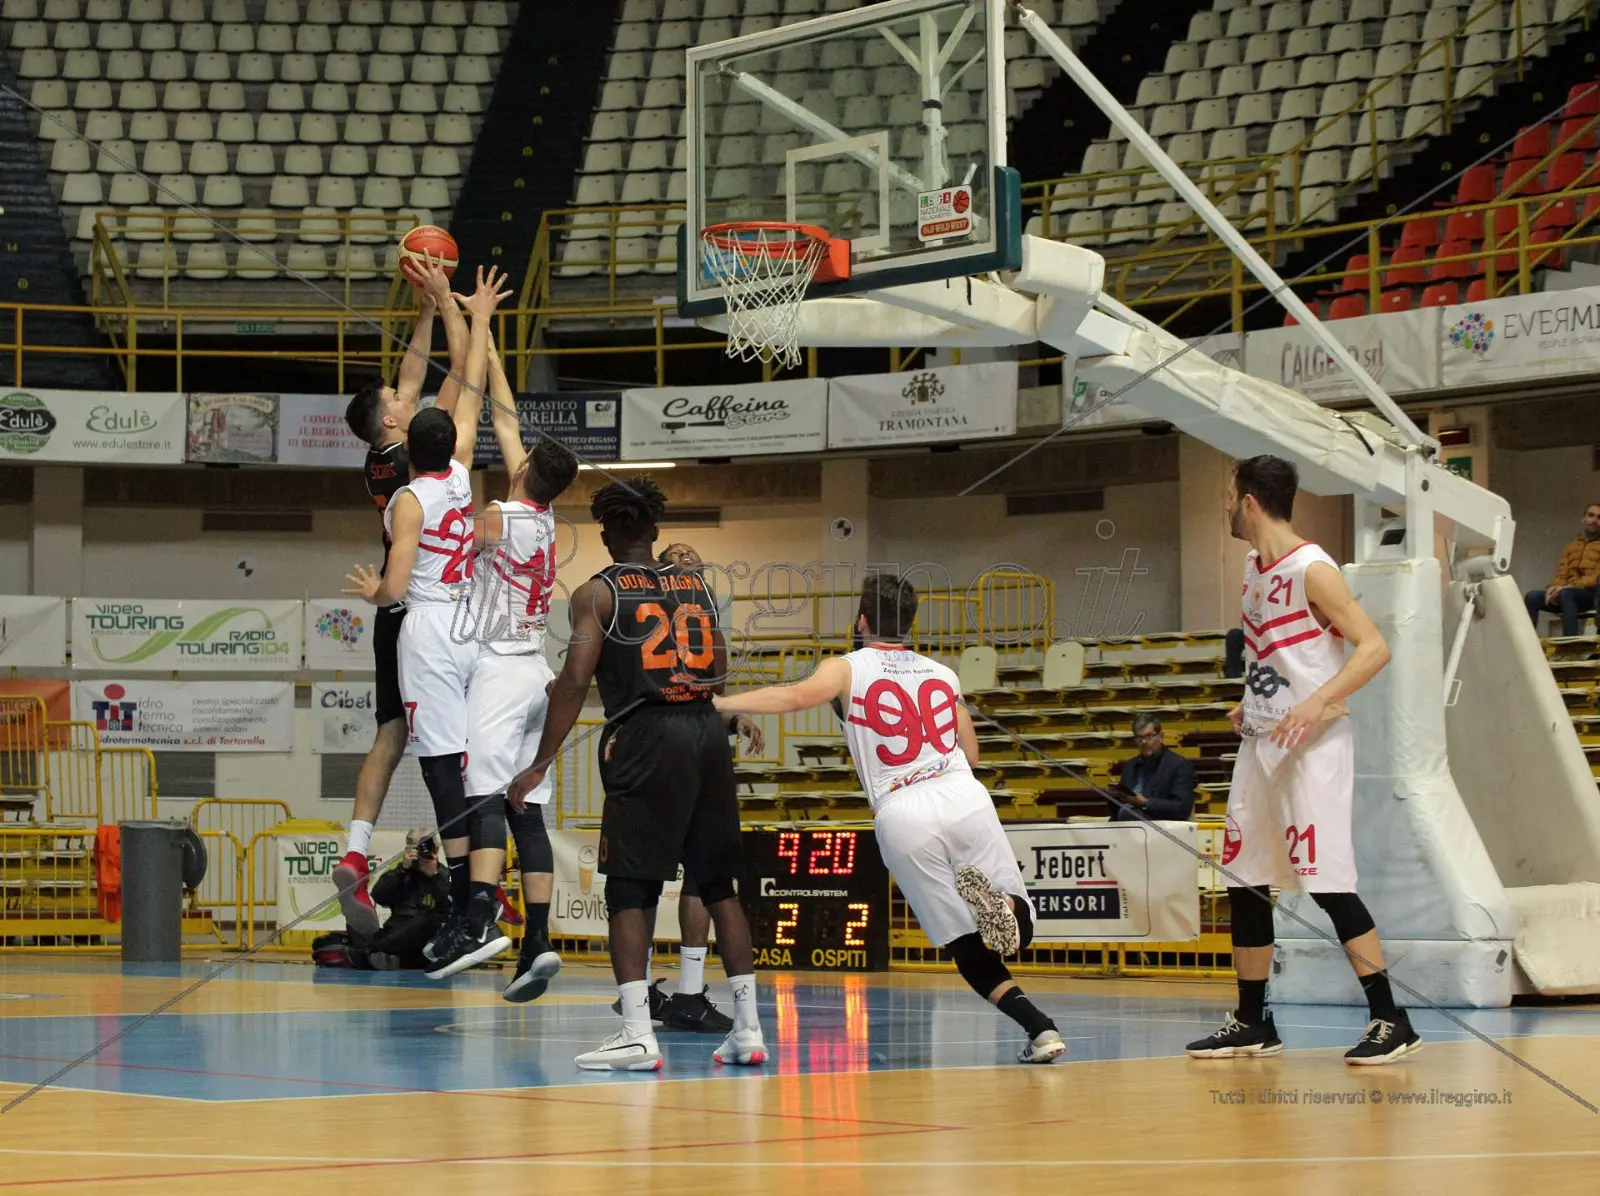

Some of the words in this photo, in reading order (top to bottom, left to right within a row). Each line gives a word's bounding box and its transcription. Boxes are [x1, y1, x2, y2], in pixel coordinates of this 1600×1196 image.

[922, 225, 934, 234] OLD
[935, 222, 951, 233] WILD
[951, 219, 968, 231] WEST
[516, 401, 578, 411] COLASTICO
[662, 395, 788, 421] Caffeina
[85, 405, 158, 434] Edulè
[878, 415, 968, 432] TRAMONTANA
[302, 438, 339, 449] REGGIO
[1267, 574, 1293, 607] 21
[96, 604, 144, 615] VIDEO
[85, 614, 185, 630] TOURING
[229, 630, 276, 641] RADIO
[635, 603, 715, 670] 20
[138, 696, 164, 709] idro
[221, 695, 279, 707] specializzato
[138, 709, 176, 721] termo
[192, 705, 254, 715] riscaldamento
[192, 714, 268, 724] condizionamento
[864, 678, 958, 766] 90
[138, 721, 184, 733] tecnica
[99, 736, 181, 745] idrotermotecnica
[206, 736, 217, 745] di
[219, 736, 265, 745] Tortorella
[294, 841, 339, 855] VIDEO
[1285, 823, 1316, 864] 21
[808, 831, 856, 875] 20
[1031, 845, 1110, 880] Febert
[775, 903, 799, 945] 2
[844, 903, 869, 946] 2
[752, 948, 793, 967] CASA
[811, 948, 867, 968] OSPITI
